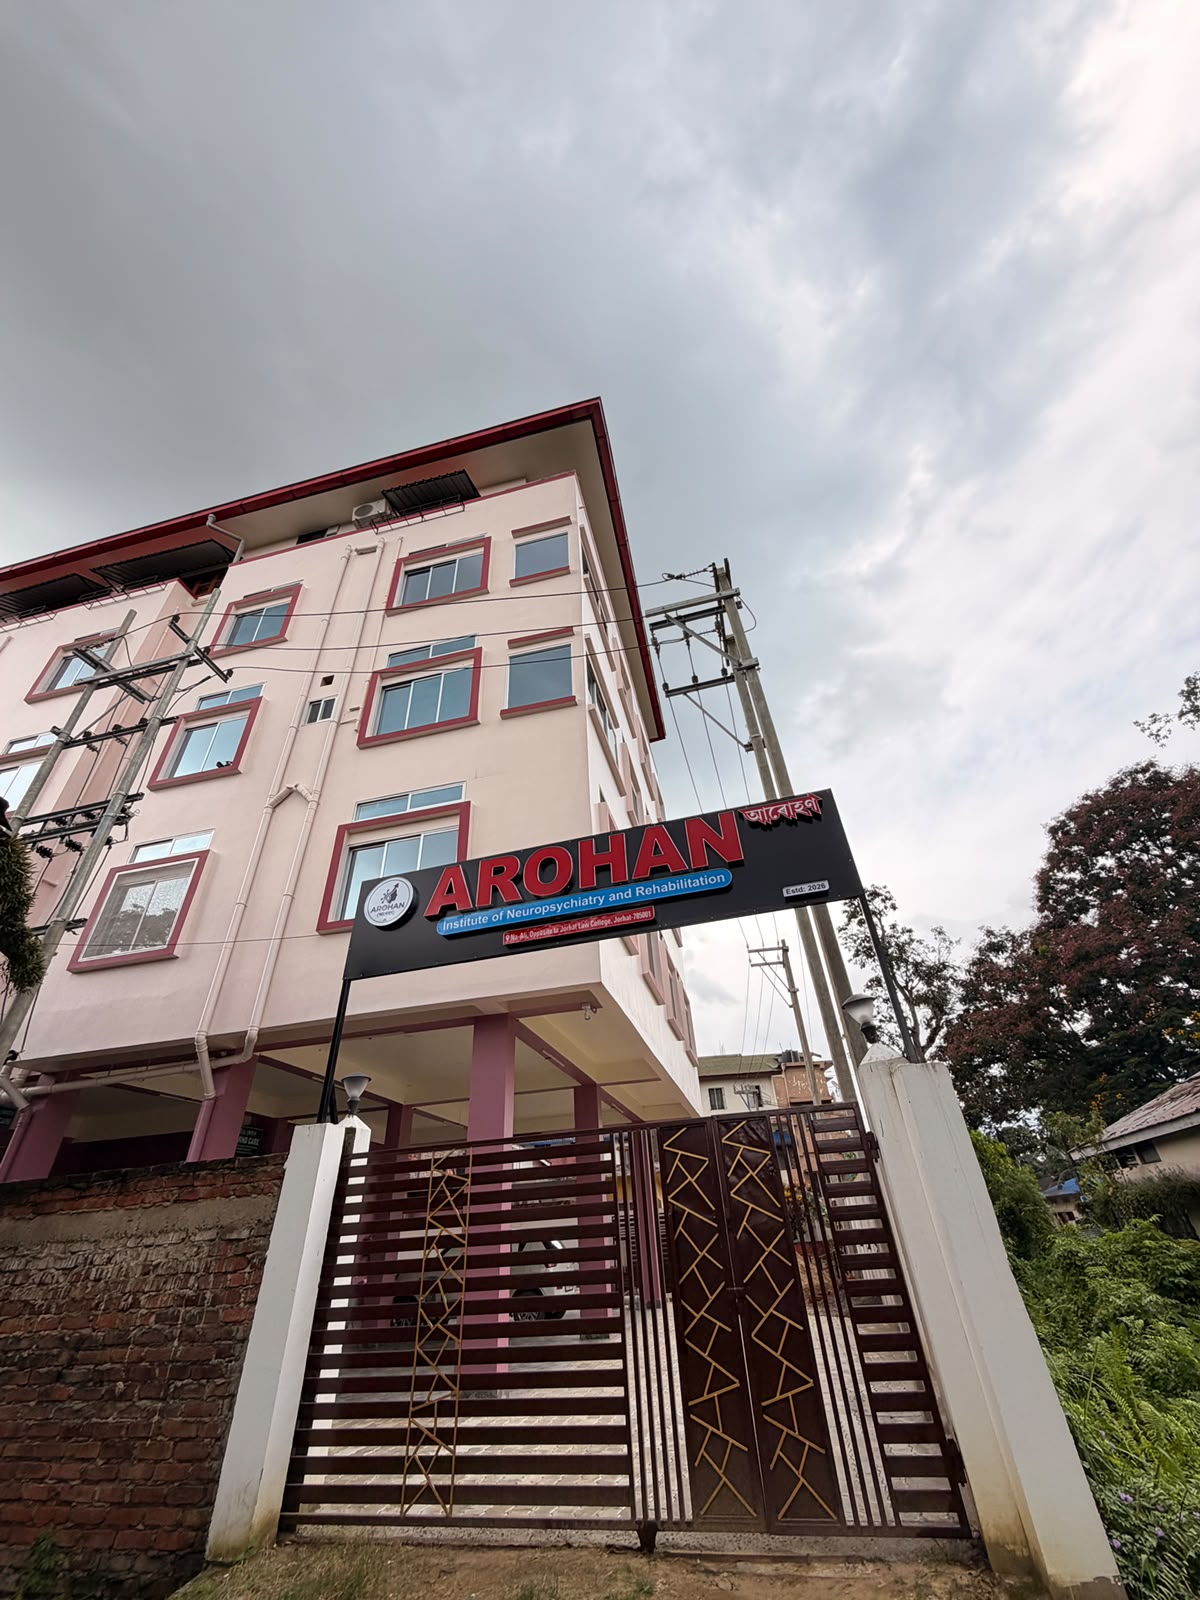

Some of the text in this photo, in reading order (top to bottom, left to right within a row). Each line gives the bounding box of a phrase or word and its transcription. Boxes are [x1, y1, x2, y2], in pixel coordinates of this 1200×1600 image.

[424, 810, 744, 917] AROHAN
[370, 902, 405, 913] AROHAN
[442, 873, 726, 930] Institute of Neuropsychiatry and Rehabilitation
[560, 923, 578, 933] Jorhat
